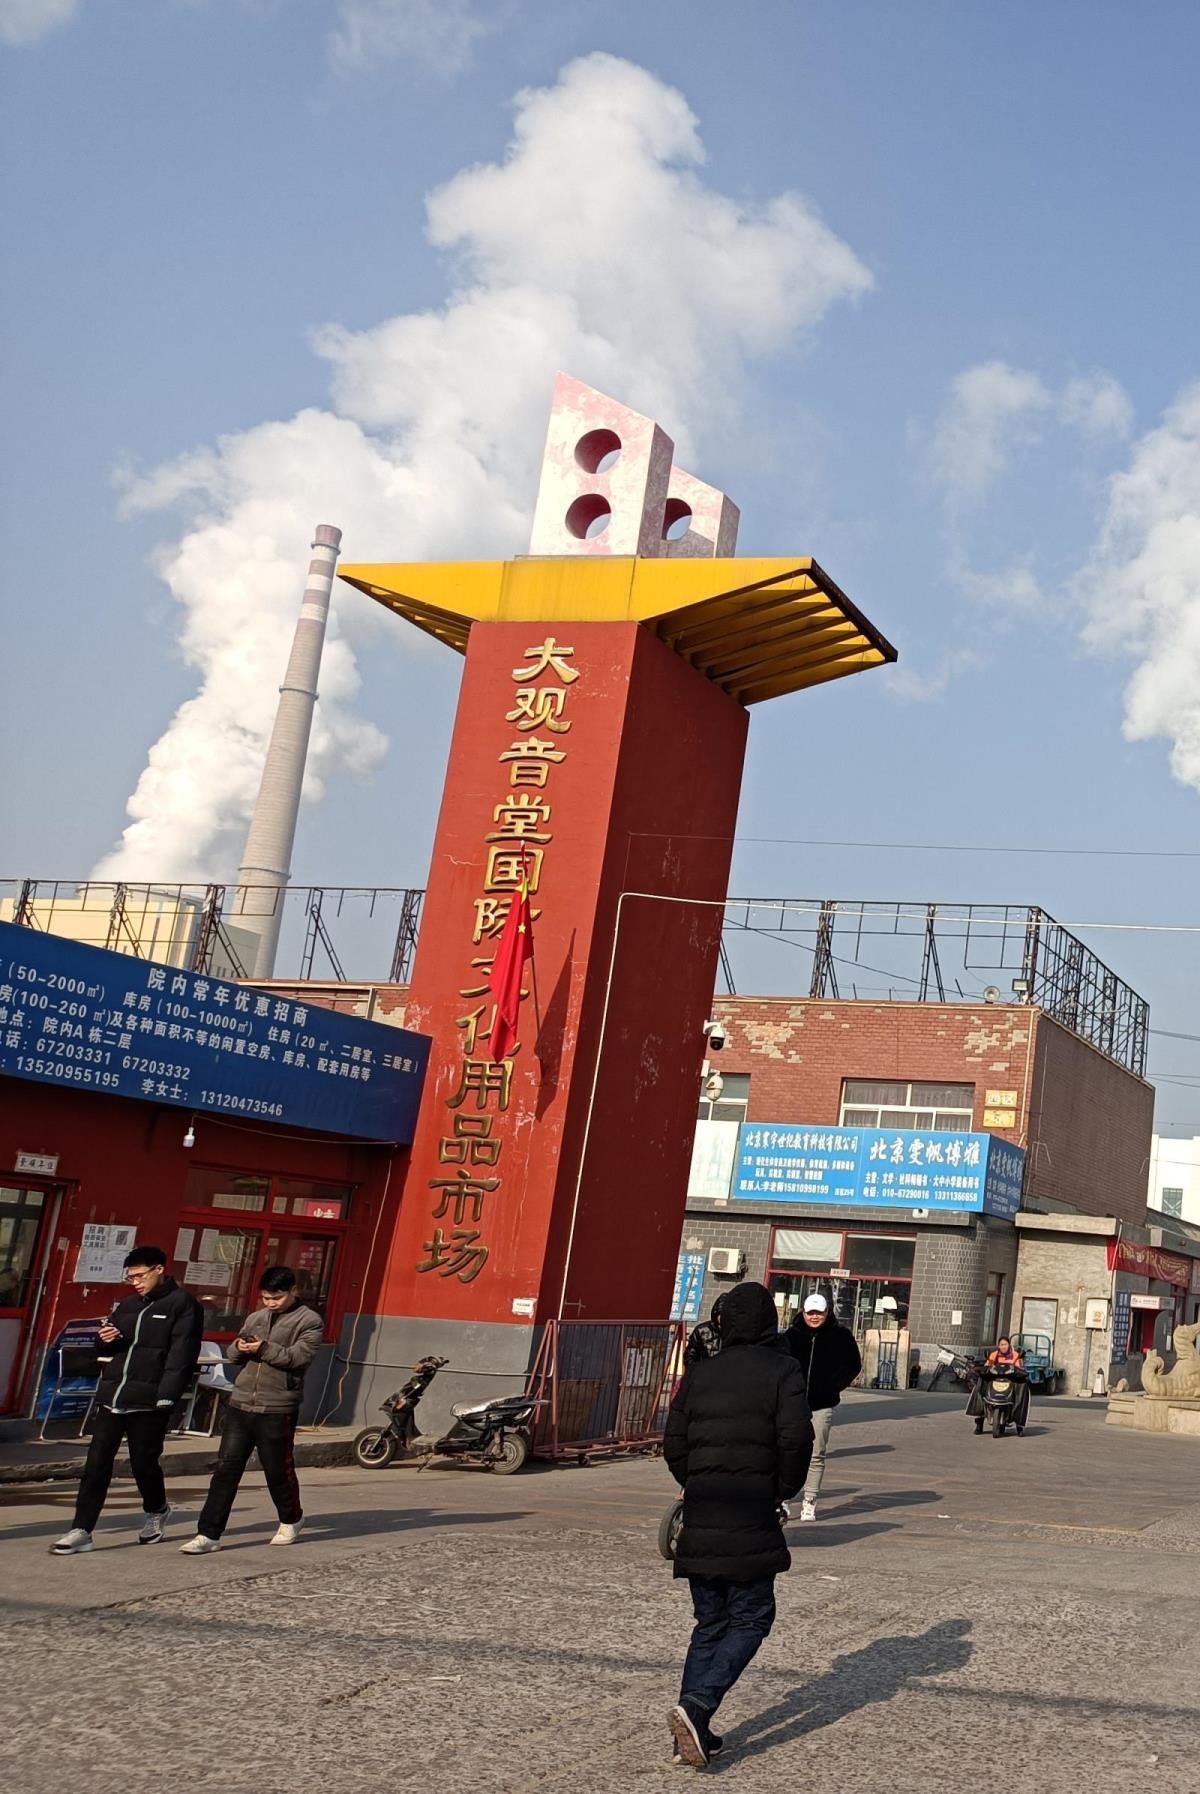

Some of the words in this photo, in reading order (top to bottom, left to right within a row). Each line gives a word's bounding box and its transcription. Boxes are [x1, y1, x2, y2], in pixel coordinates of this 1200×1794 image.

[147, 967, 309, 1027] 院内常年优惠招商
[0, 1030, 111, 1065] 话：67203331
[122, 1055, 191, 1080] 67203332
